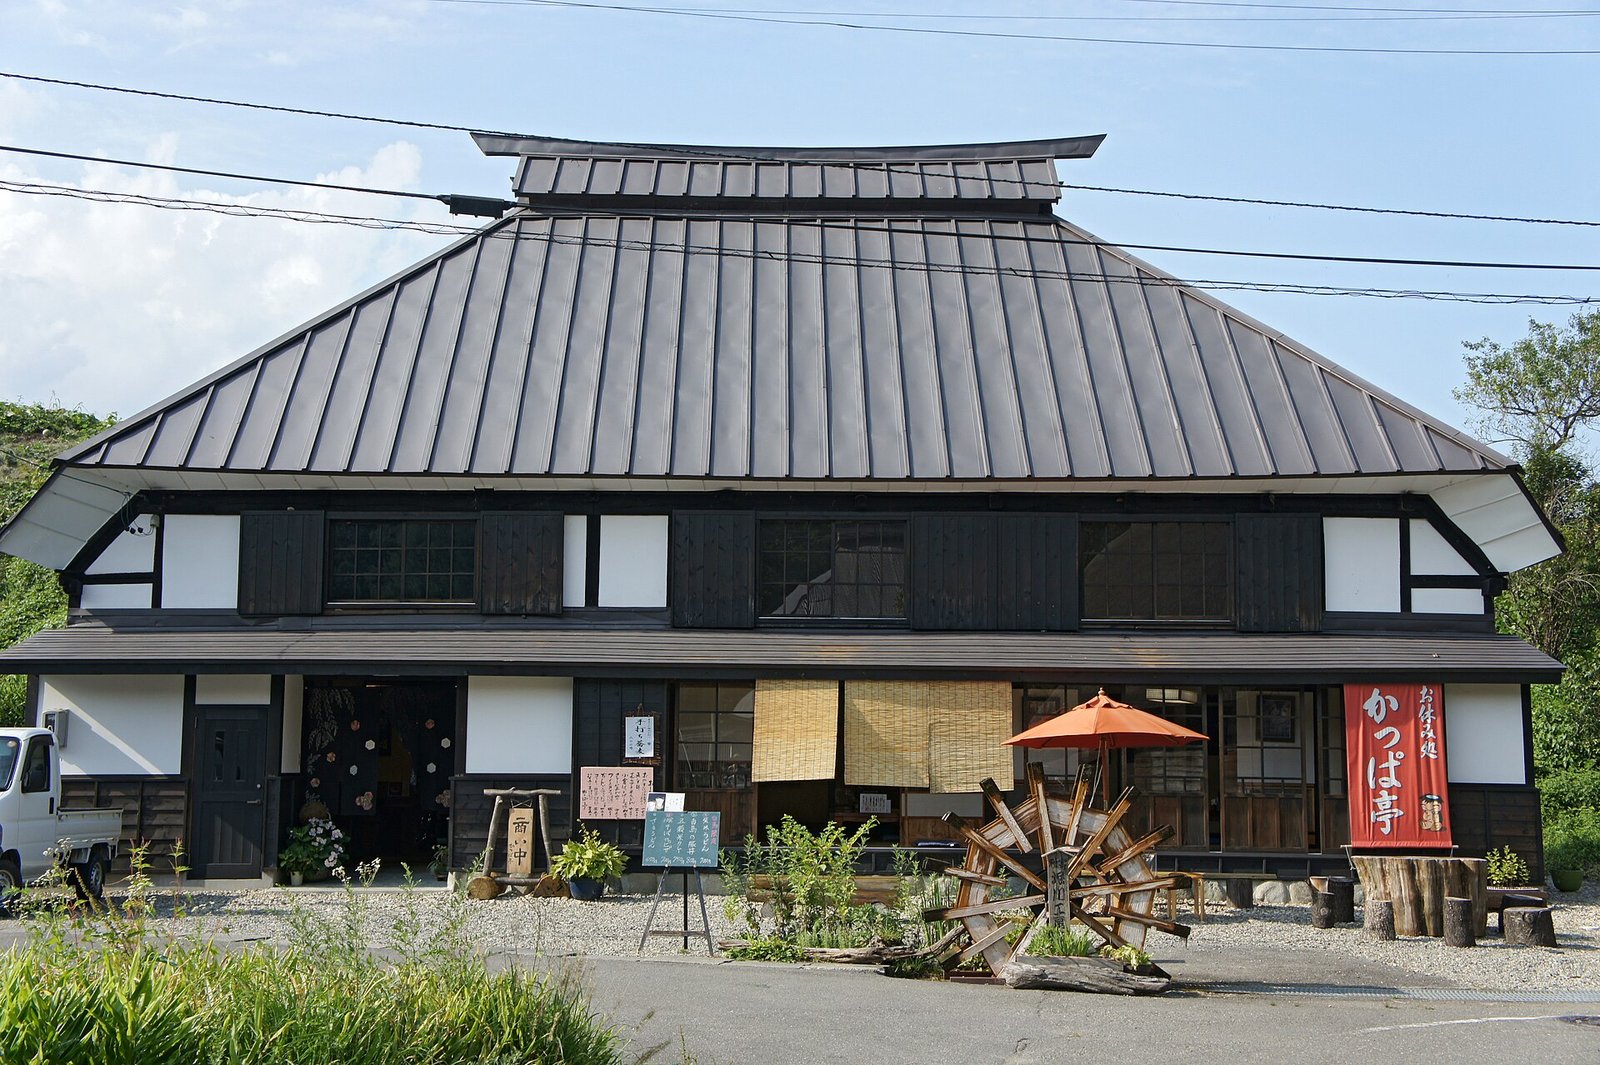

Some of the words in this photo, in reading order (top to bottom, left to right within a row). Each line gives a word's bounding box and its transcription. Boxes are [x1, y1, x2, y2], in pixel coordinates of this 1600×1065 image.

[1418, 685, 1438, 760] お休み処
[1362, 687, 1406, 837] かっぱ亭
[513, 816, 530, 867] 商い中
